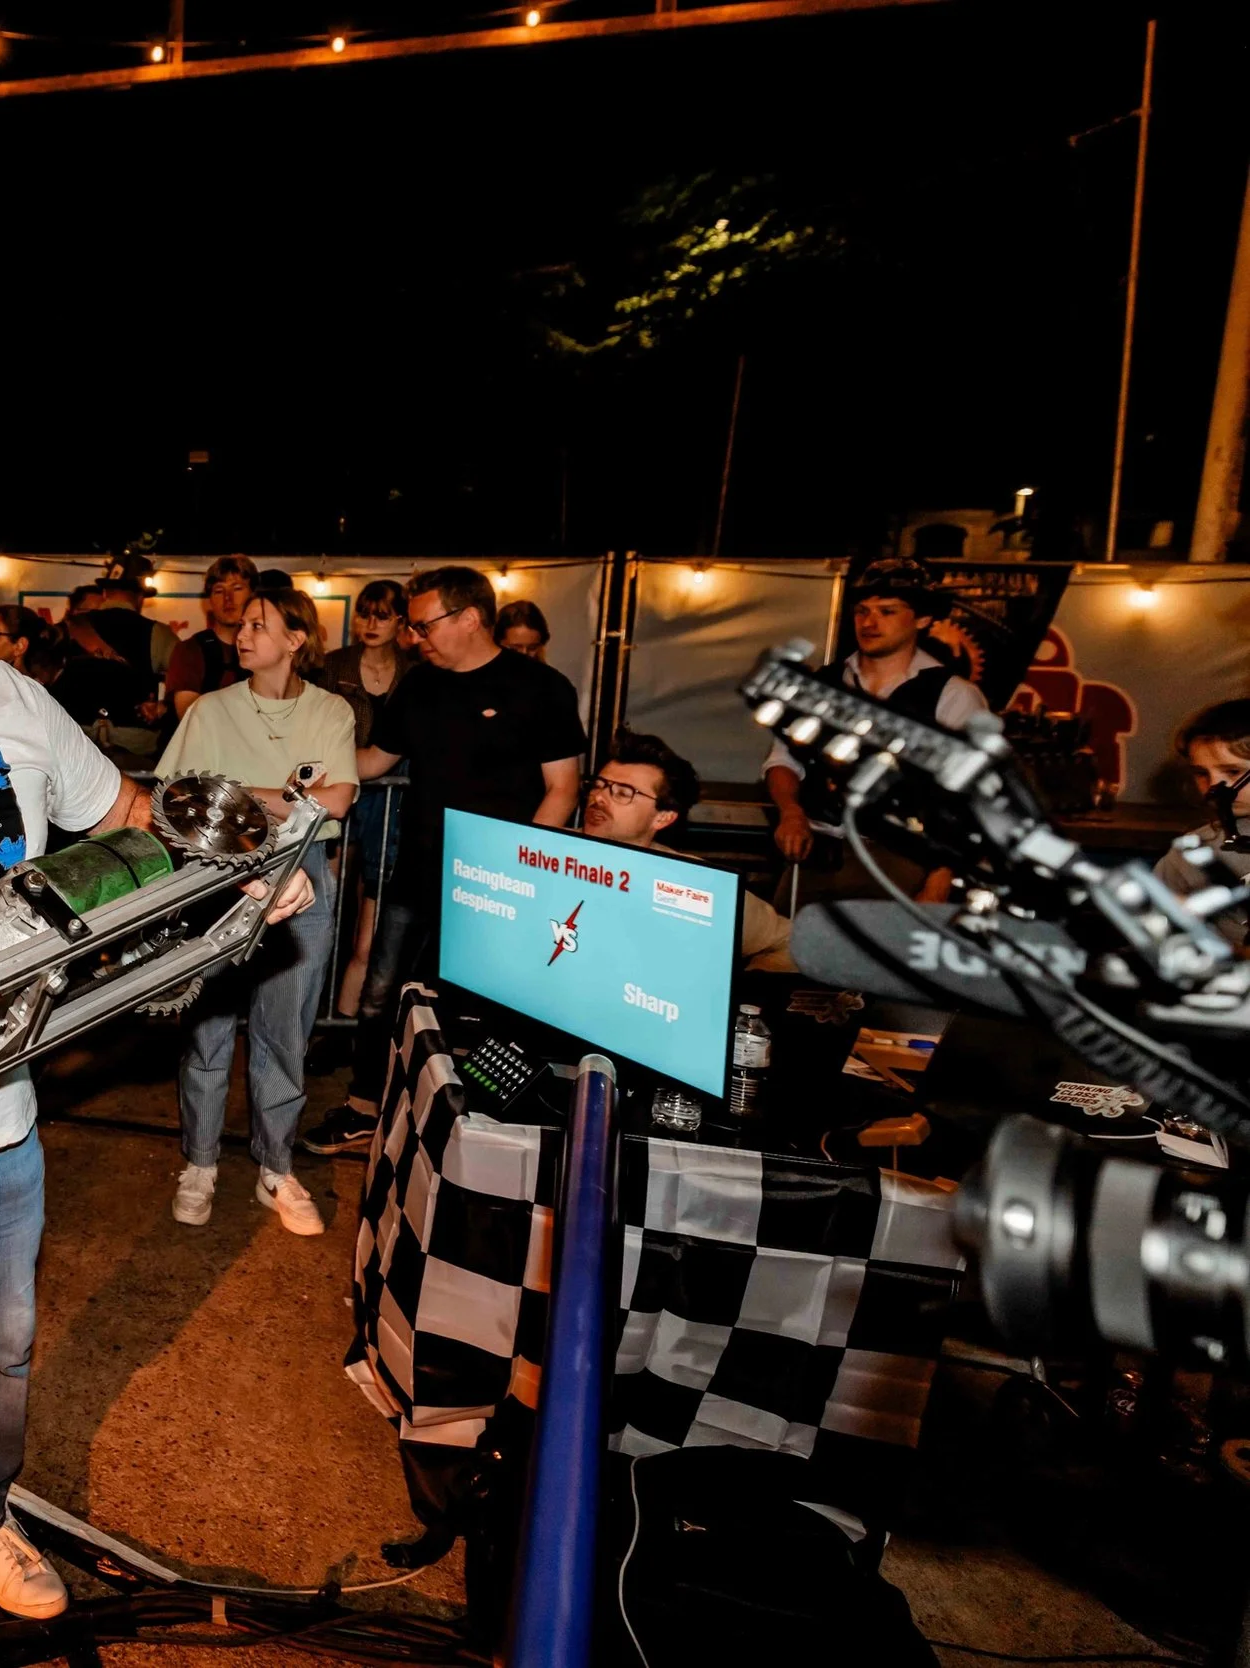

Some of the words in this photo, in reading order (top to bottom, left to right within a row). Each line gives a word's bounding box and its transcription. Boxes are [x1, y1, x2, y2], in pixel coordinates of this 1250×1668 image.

[453, 858, 535, 898] Racingteam
[518, 845, 559, 873] Halve
[565, 857, 613, 887] Finale
[619, 871, 630, 892] 2
[452, 886, 516, 920] despierre
[656, 882, 684, 896] Maker
[686, 889, 710, 903] Faire
[550, 919, 578, 952] VS
[623, 982, 679, 1022] Sharp
[1053, 1096, 1099, 1104] HEROES
[1058, 1083, 1113, 1093] WORKING
[1060, 1090, 1099, 1098] CLASS
